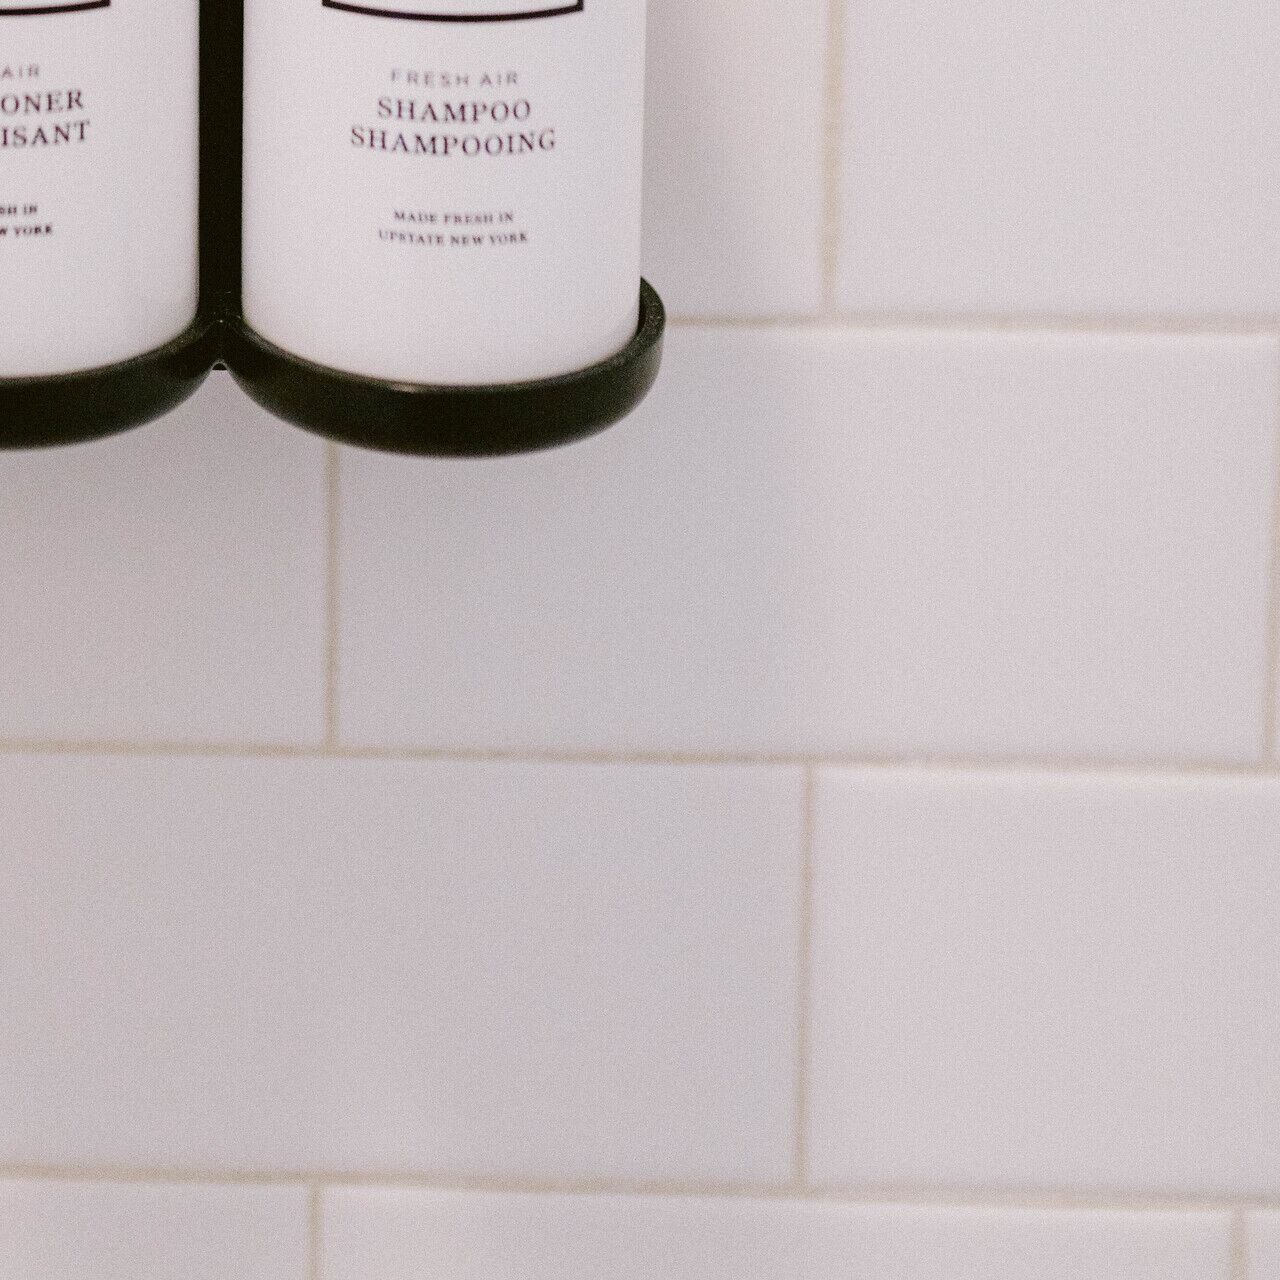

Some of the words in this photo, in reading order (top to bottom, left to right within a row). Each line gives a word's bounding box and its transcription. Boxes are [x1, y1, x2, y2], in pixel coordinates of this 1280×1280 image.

[0, 63, 40, 79] AIR
[390, 69, 470, 87] FRESH
[480, 71, 518, 87] AIR
[377, 97, 532, 124] SHAMPOO
[350, 125, 556, 157] SHAMPOOING
[22, 203, 40, 217] IN
[392, 210, 438, 225] MADE
[443, 213, 495, 226] FRESH
[498, 211, 515, 224] IN
[13, 223, 55, 238] YORK
[377, 228, 446, 247] UPSTATE
[449, 234, 485, 247] NEW
[489, 231, 529, 245] YORK
